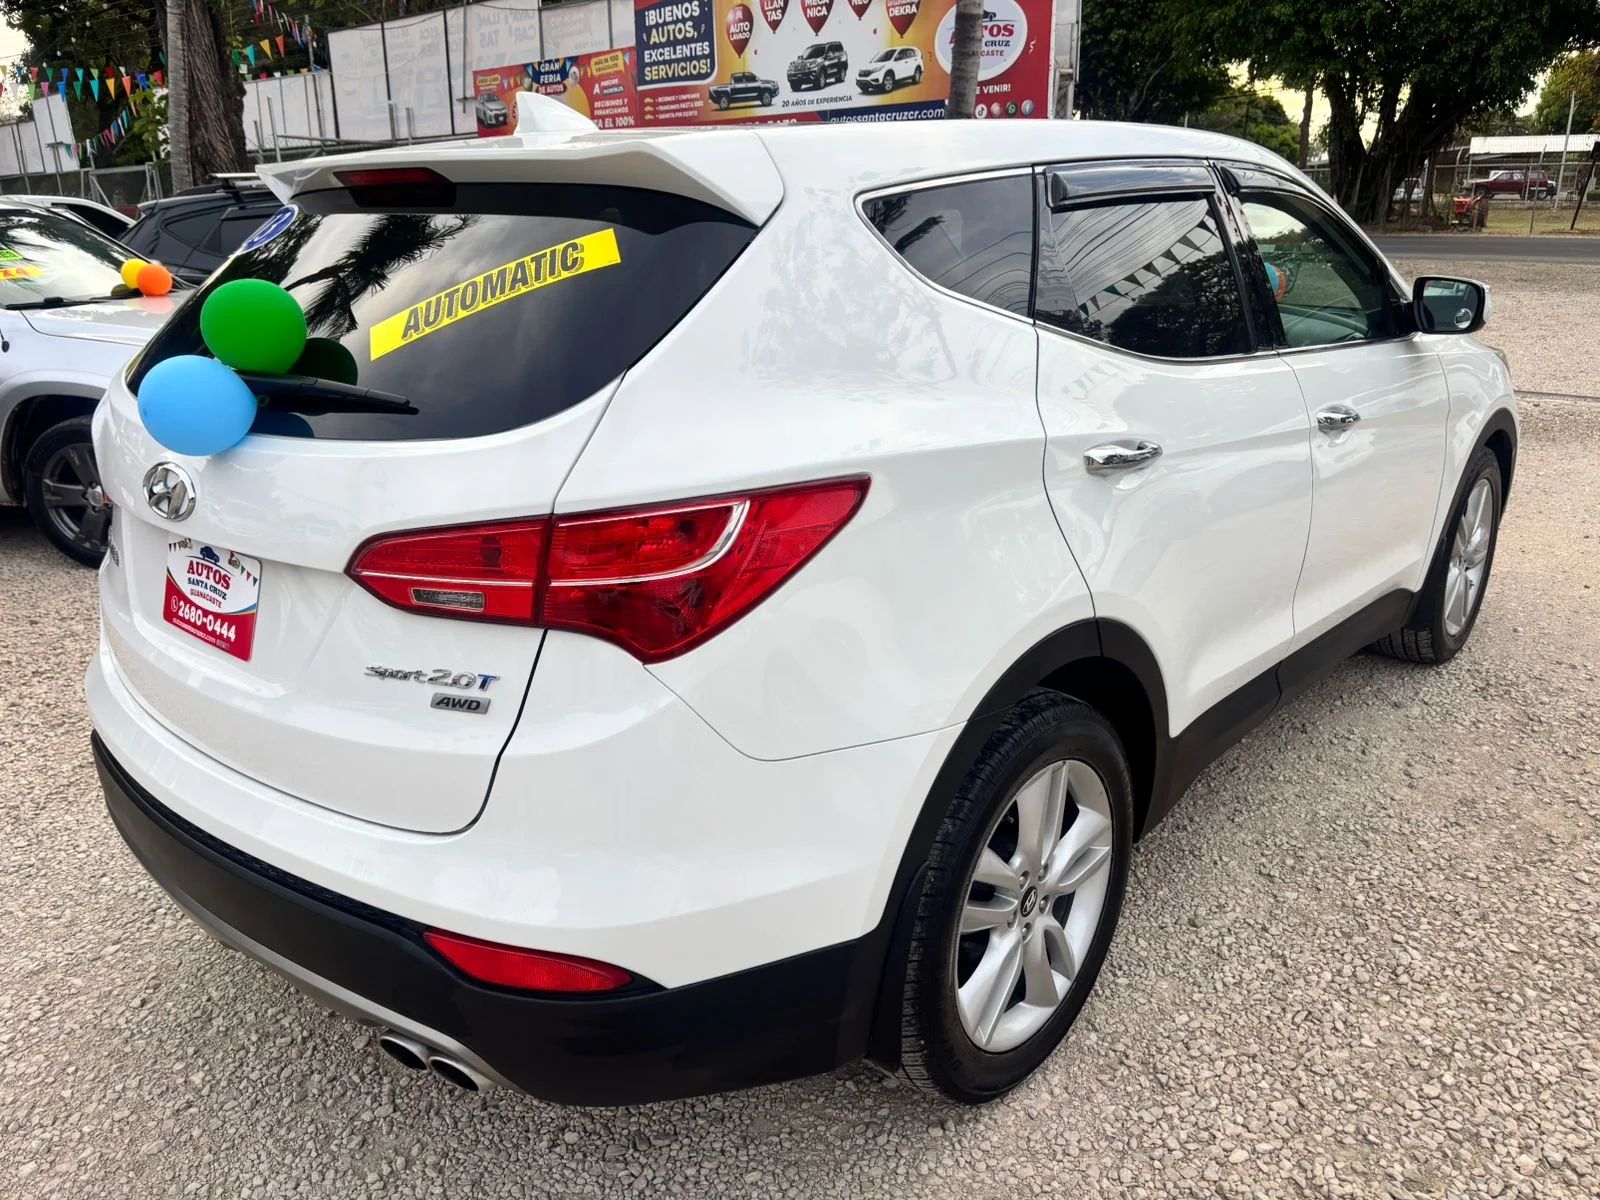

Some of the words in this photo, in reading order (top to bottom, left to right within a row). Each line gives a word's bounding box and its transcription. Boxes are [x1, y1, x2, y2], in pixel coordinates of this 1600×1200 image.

[645, 0, 700, 26] ¡BUENOS
[767, 9, 782, 21] TAS
[807, 6, 828, 18] NICA
[889, 4, 917, 17] DEKRA
[650, 21, 697, 45] AUTOS,
[729, 22, 750, 34] AUTO
[729, 31, 751, 41] LAVADO
[984, 39, 1011, 47] CRUZ
[644, 42, 710, 63] EXCELENTES
[540, 62, 560, 72] GRAN
[644, 58, 711, 81] SERVICIOS!
[540, 74, 561, 84] FERIA
[546, 84, 564, 93] AUTOS
[593, 83, 600, 94] A
[983, 84, 1011, 94] VENIR!
[594, 99, 623, 108] RECIBIMOS
[782, 100, 790, 108] 20
[790, 98, 806, 107] AÑOS
[816, 96, 852, 105] EXPERIENCIA
[594, 106, 628, 116] FINANCIAMOS
[605, 118, 614, 128] EL
[615, 116, 635, 127] 100%
[401, 241, 585, 342] AUTOMATIC
[187, 560, 231, 591] AUTOS
[187, 577, 208, 591] SANTA
[209, 584, 227, 600] CRUZ
[190, 588, 222, 609] GUANACASTE
[178, 600, 236, 642] 2680-0444
[435, 696, 482, 711] AWD
